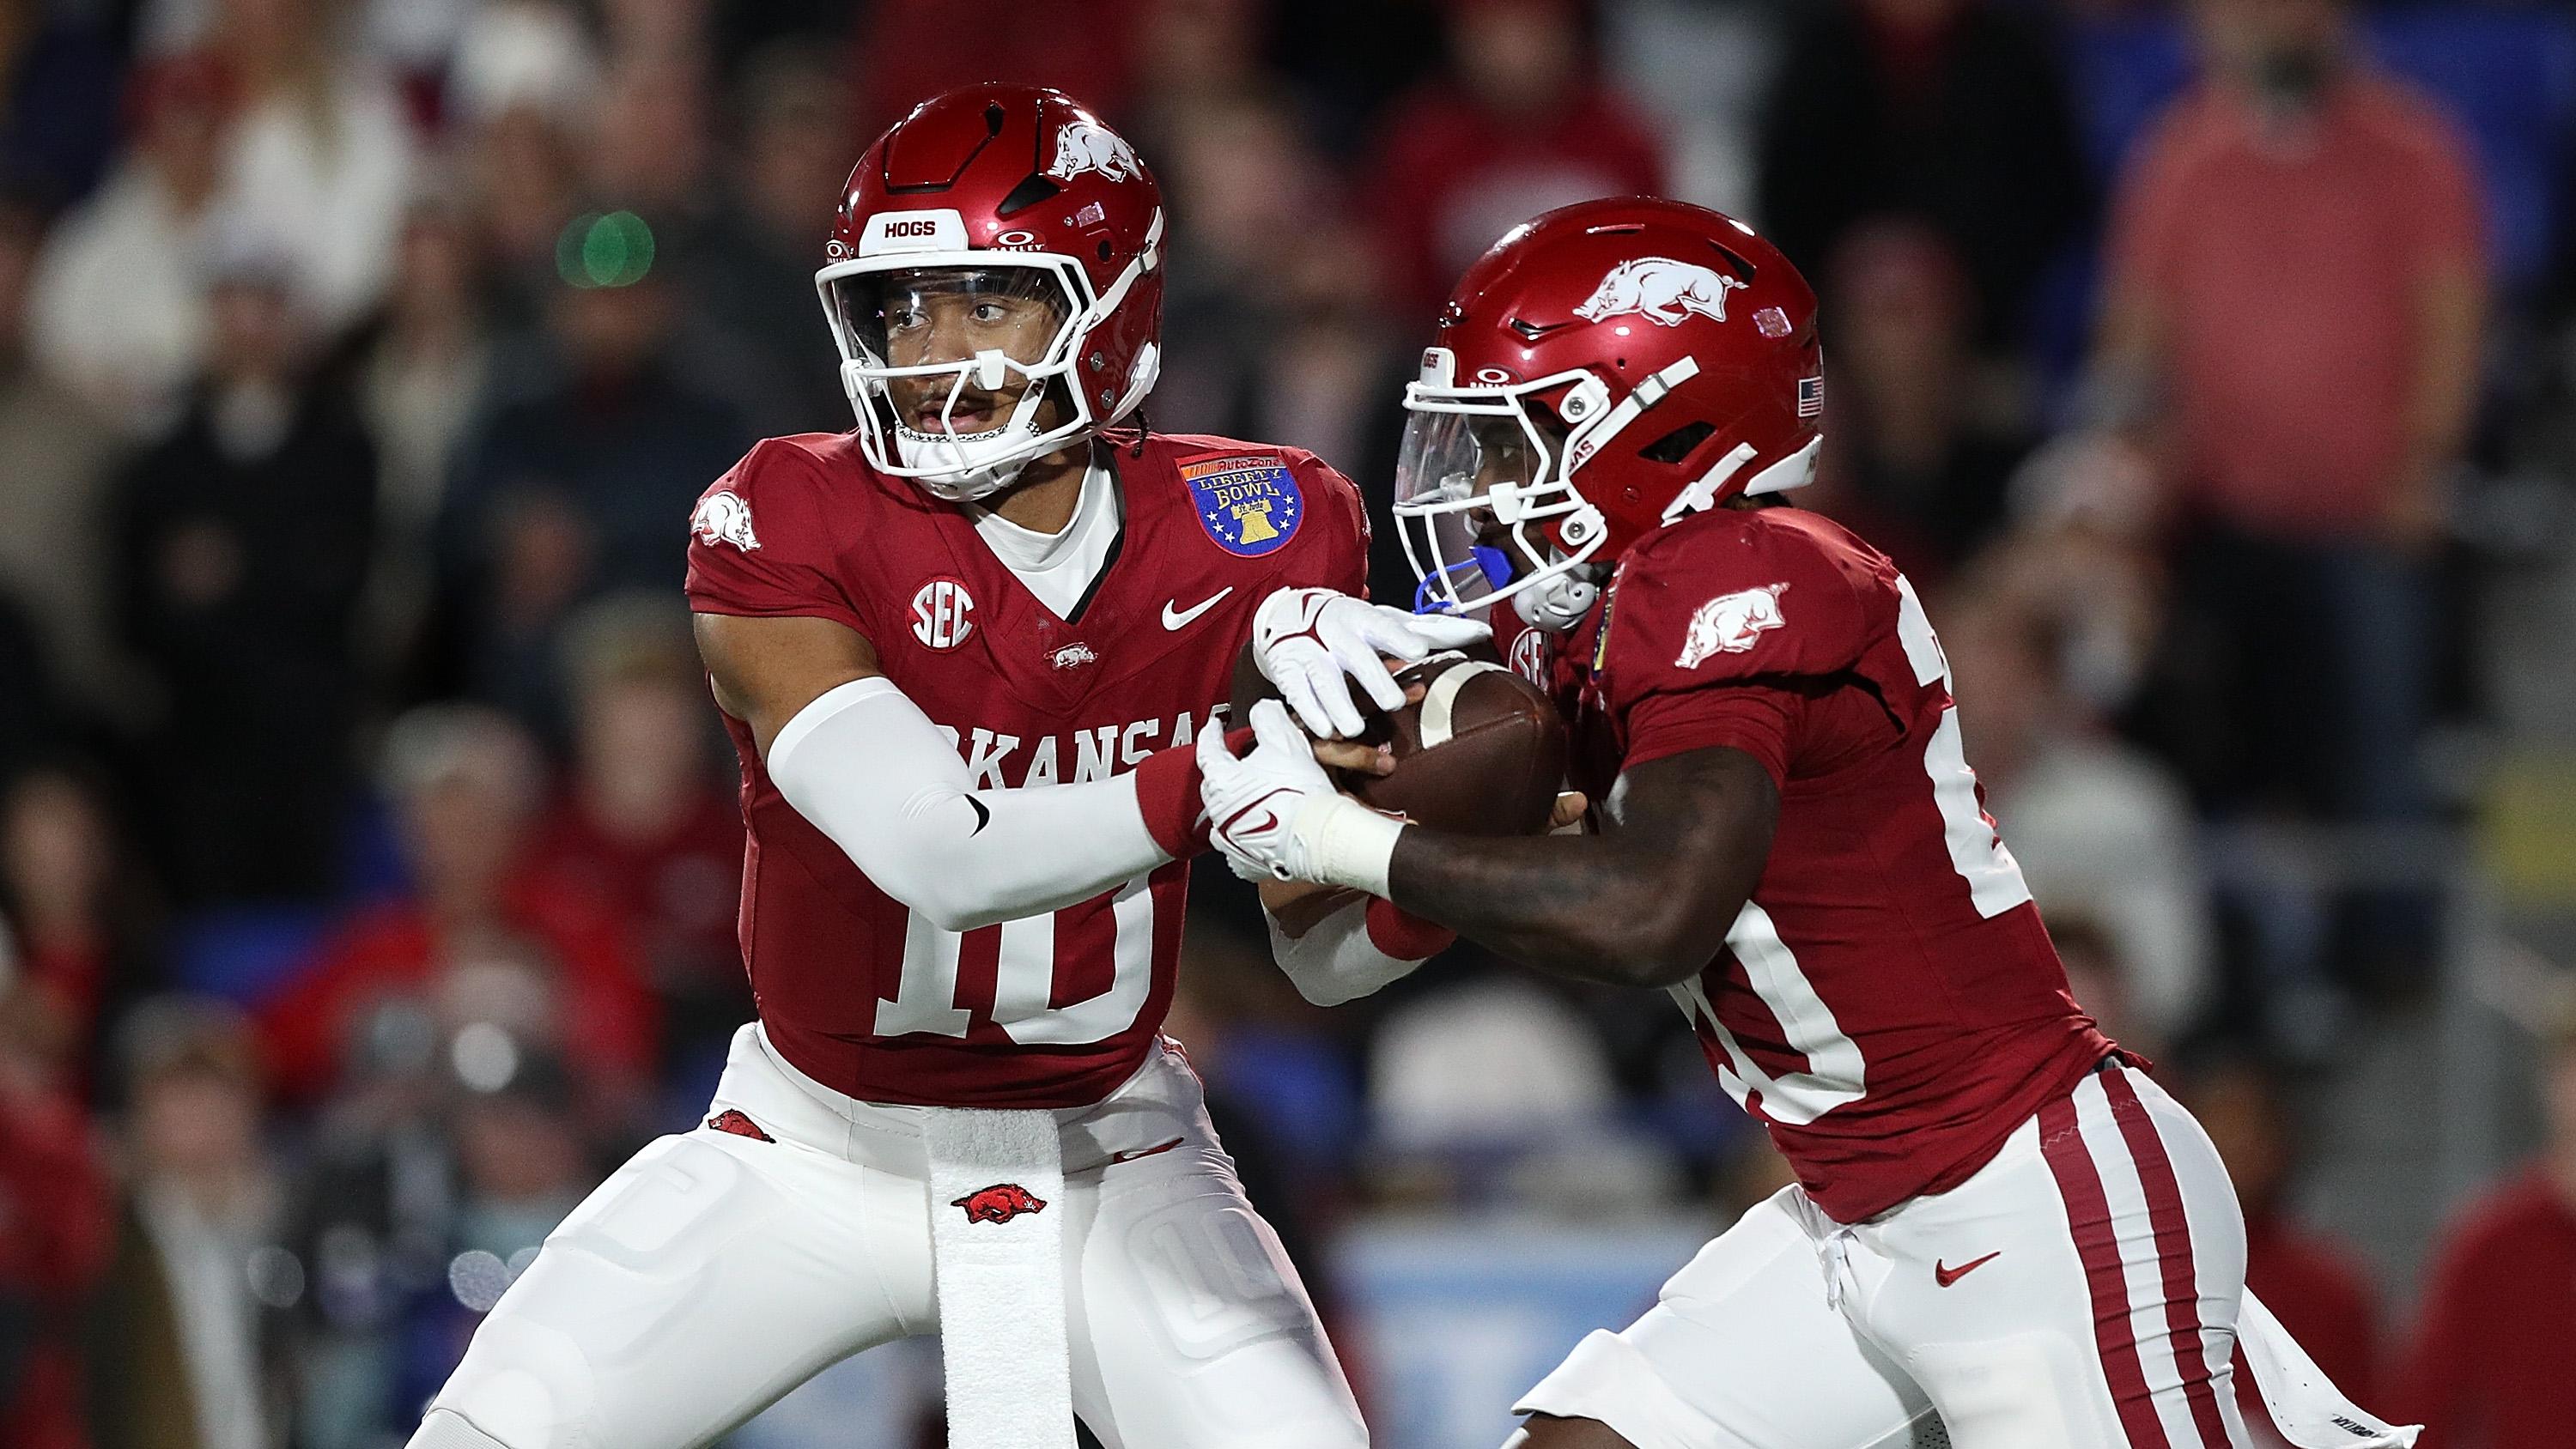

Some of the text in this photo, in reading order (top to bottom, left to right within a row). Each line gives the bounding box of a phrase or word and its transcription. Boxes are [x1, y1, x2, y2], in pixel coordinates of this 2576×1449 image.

[884, 221, 936, 239] HOGS
[1218, 458, 1279, 471] AutoZone
[1197, 469, 1283, 491] LIBERTY
[1214, 481, 1281, 510] BOWL
[912, 581, 975, 648] SEC
[874, 870, 1154, 1045] 10
